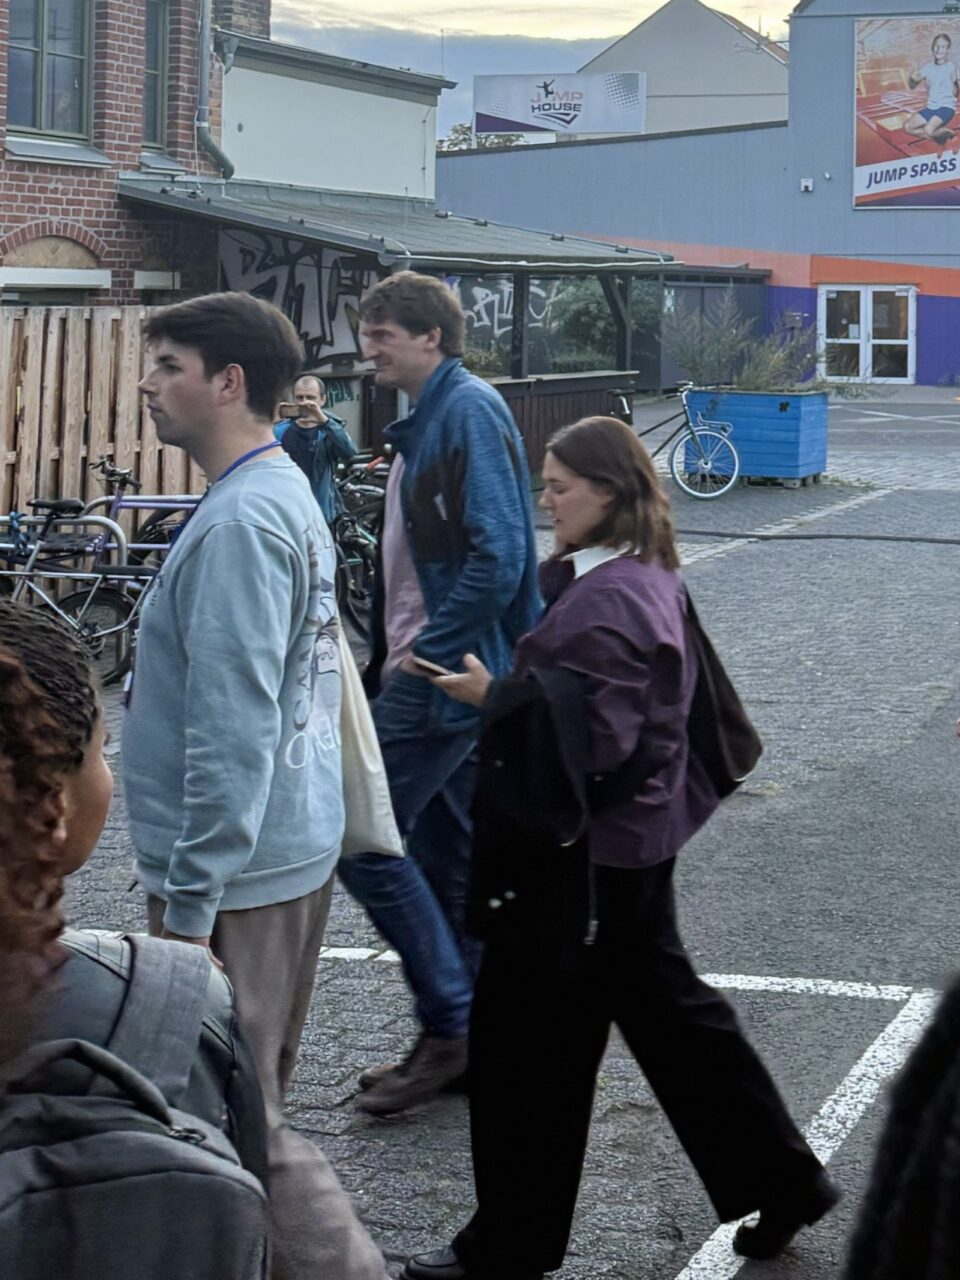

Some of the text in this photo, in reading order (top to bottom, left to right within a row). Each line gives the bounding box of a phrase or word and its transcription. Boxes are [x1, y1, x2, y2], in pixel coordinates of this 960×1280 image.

[531, 103, 582, 114] HOUSE
[866, 157, 957, 189] JUMP SPASS
